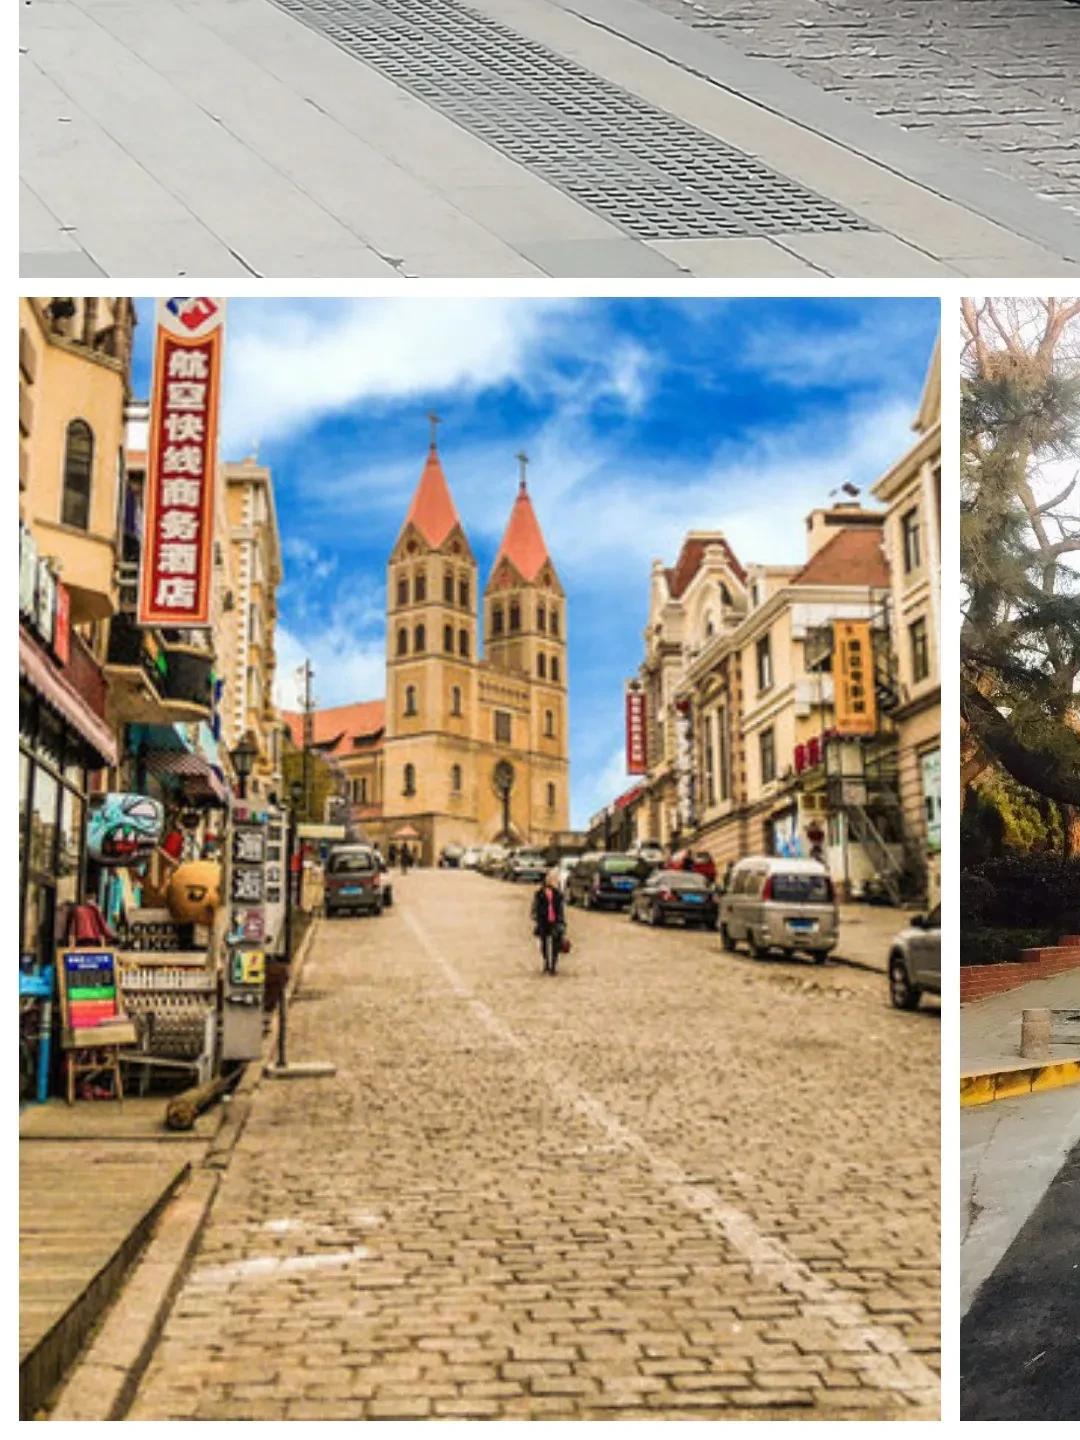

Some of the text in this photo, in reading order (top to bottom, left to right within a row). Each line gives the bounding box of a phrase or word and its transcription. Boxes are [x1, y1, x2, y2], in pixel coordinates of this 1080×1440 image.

[155, 349, 209, 609] 航空快线商务酒店
